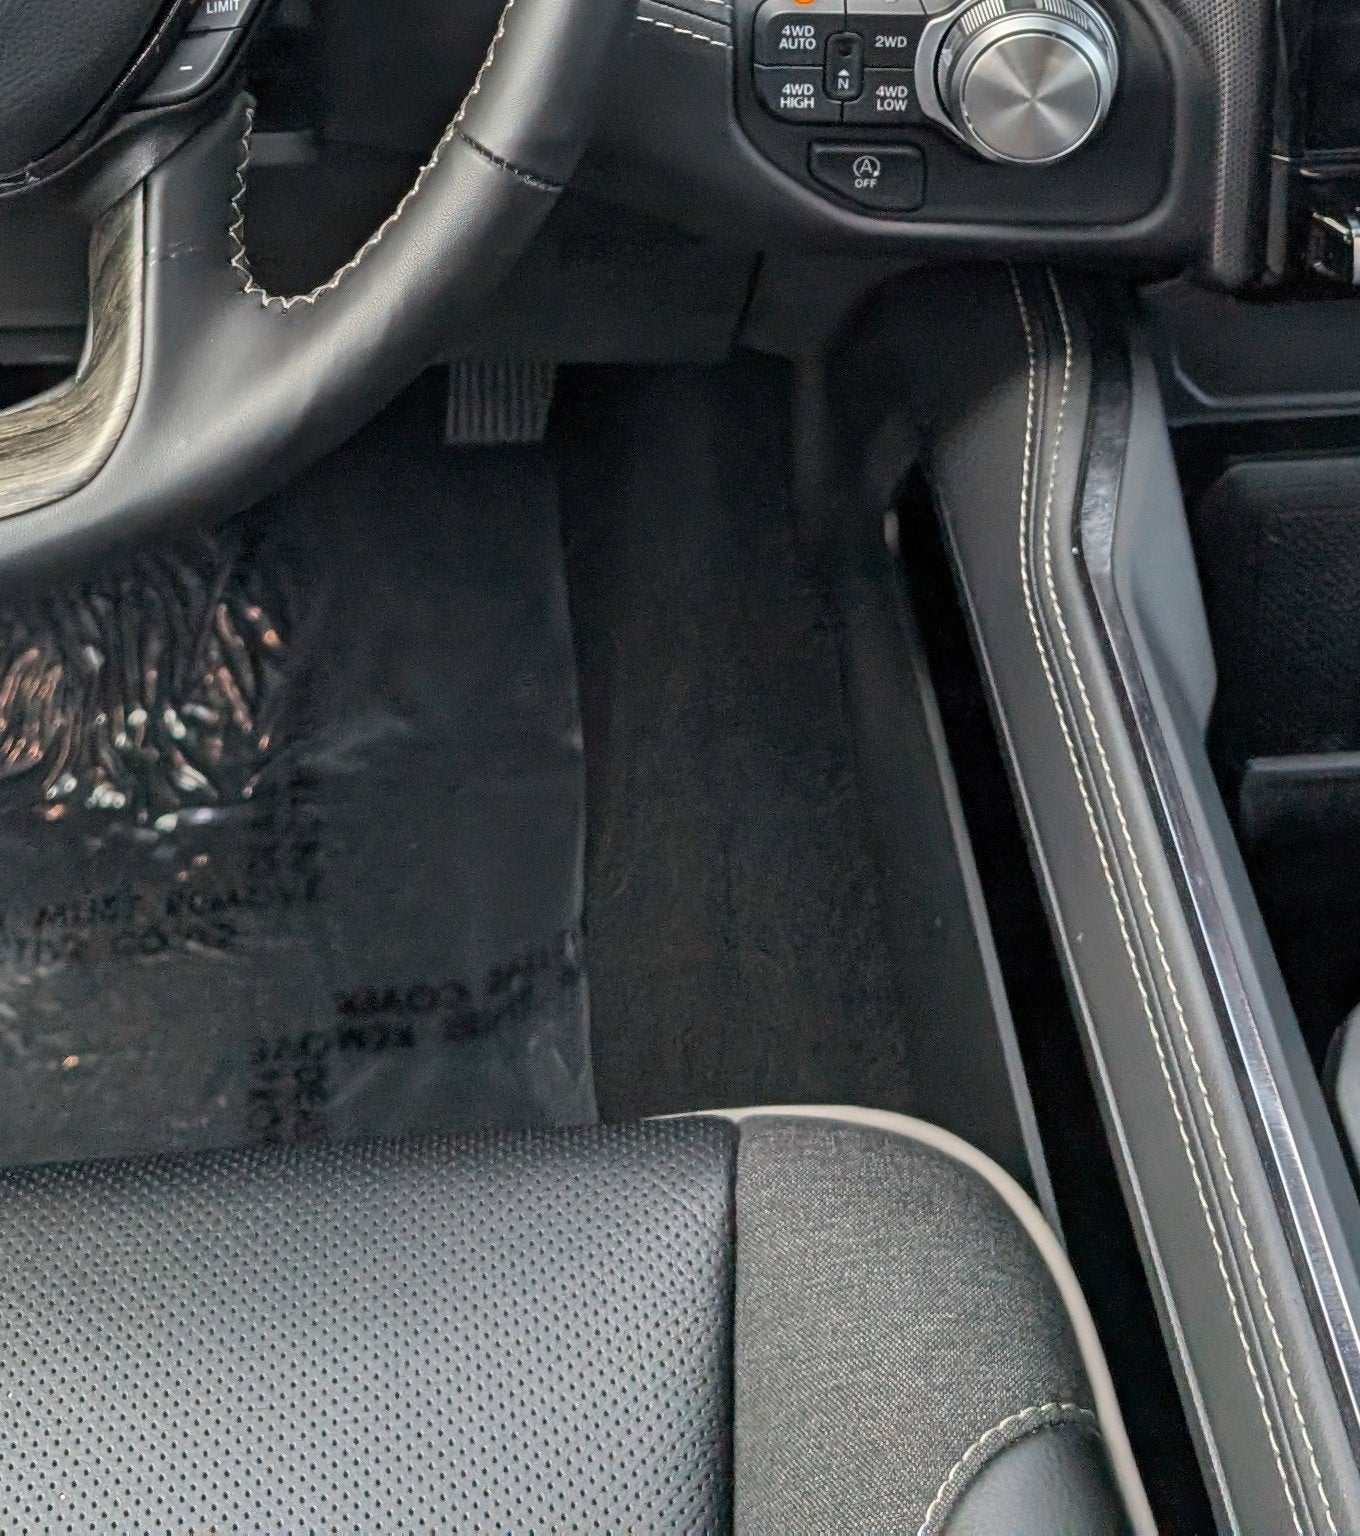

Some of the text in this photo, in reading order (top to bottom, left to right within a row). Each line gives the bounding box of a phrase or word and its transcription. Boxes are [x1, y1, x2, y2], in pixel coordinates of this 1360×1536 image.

[781, 25, 815, 38] 4WD
[779, 36, 817, 51] AUTO
[874, 35, 907, 48] 2WD
[781, 83, 815, 96] 4WD
[875, 85, 908, 98] 4WD
[779, 95, 815, 109] HIGH
[876, 98, 908, 112] LOW
[854, 177, 878, 189] OFF
